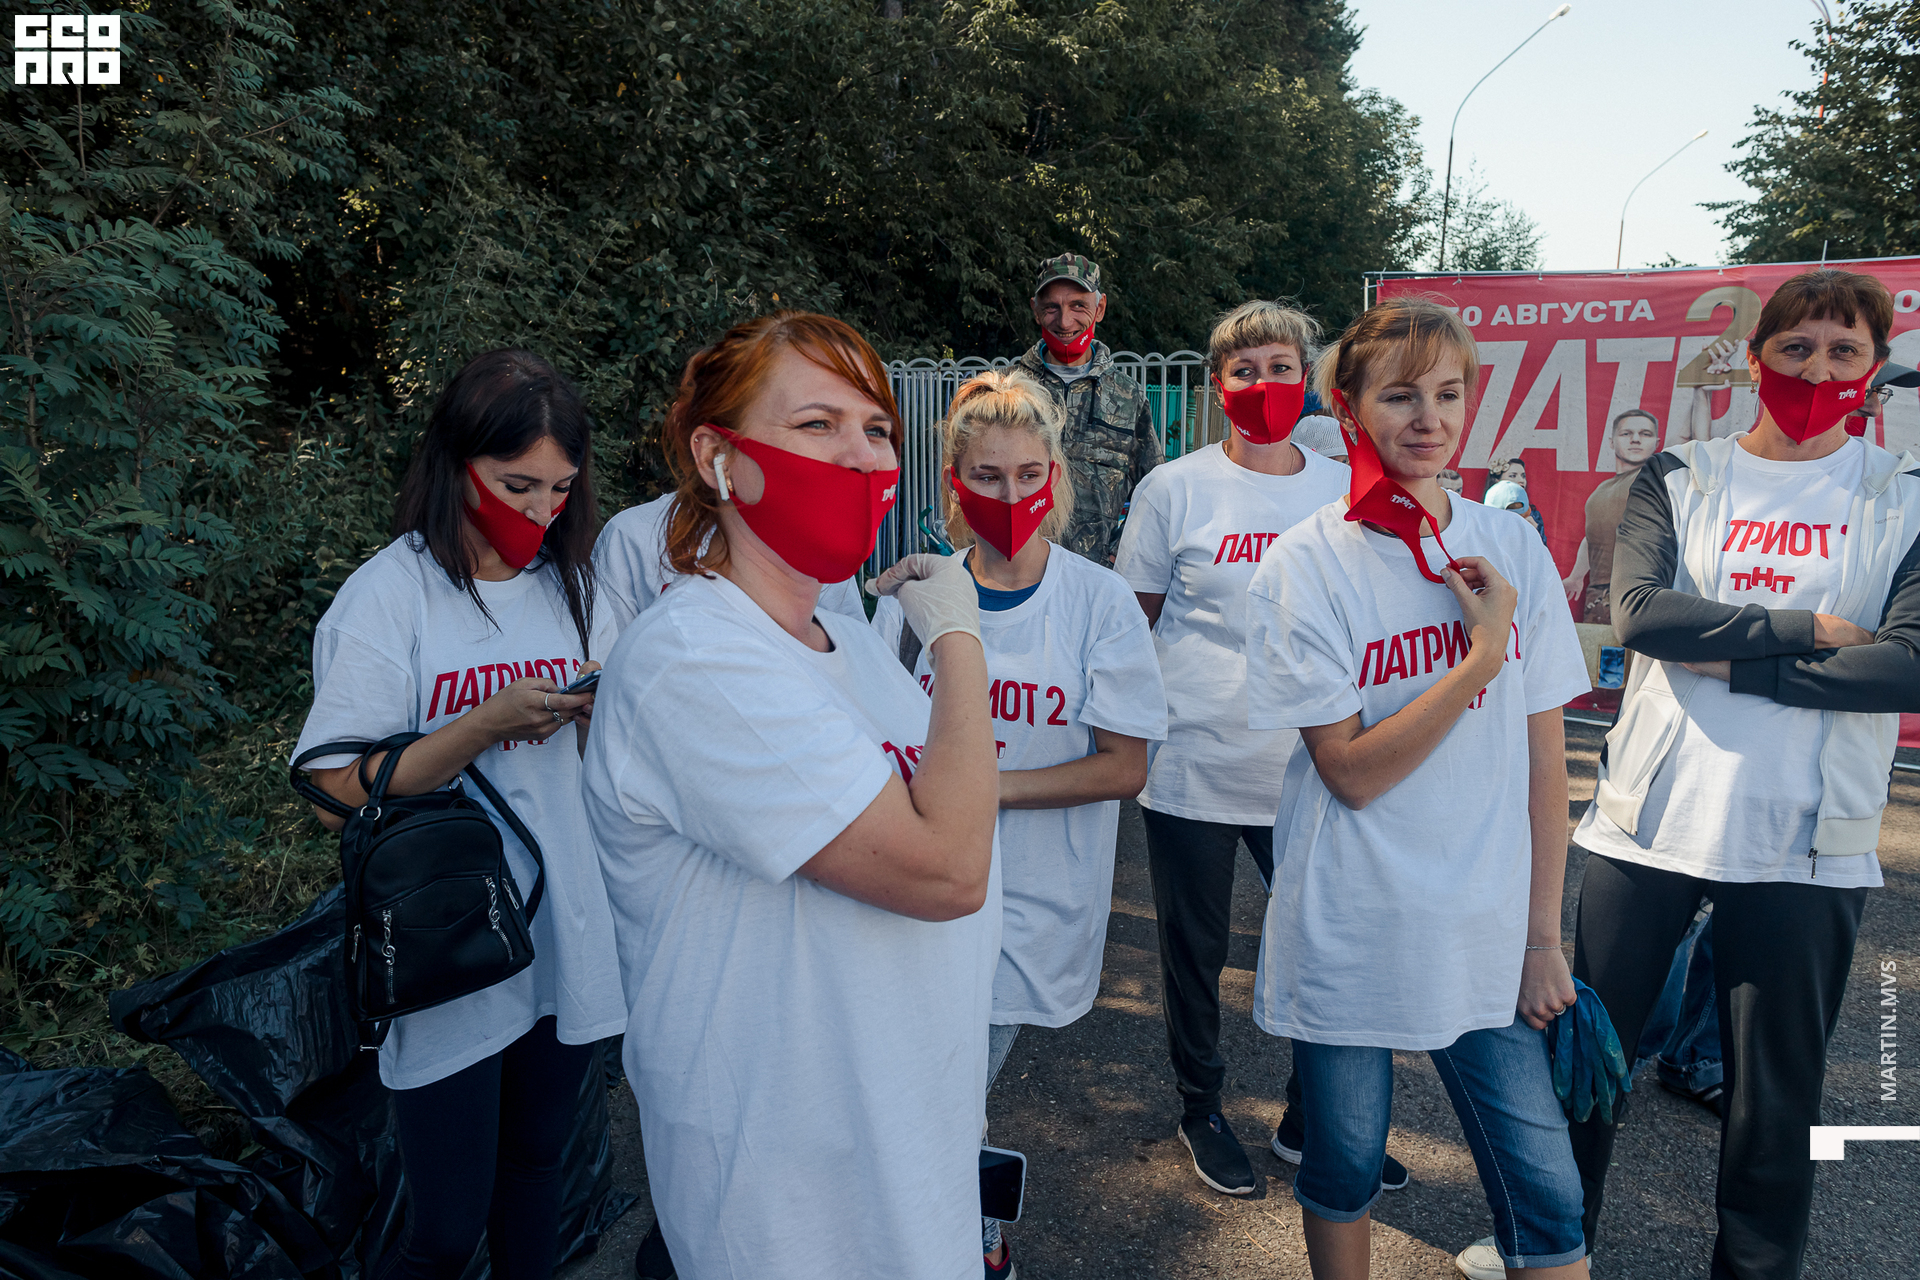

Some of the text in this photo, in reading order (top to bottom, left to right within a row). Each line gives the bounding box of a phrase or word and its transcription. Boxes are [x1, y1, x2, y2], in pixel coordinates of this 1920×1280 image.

[1449, 299, 1656, 327] 0 АВГУСТА
[1721, 519, 1831, 560] ТРИОТ
[1728, 566, 1796, 594] ТНТ
[1357, 619, 1510, 691] ПАТРИ
[1045, 685, 1068, 727] 2
